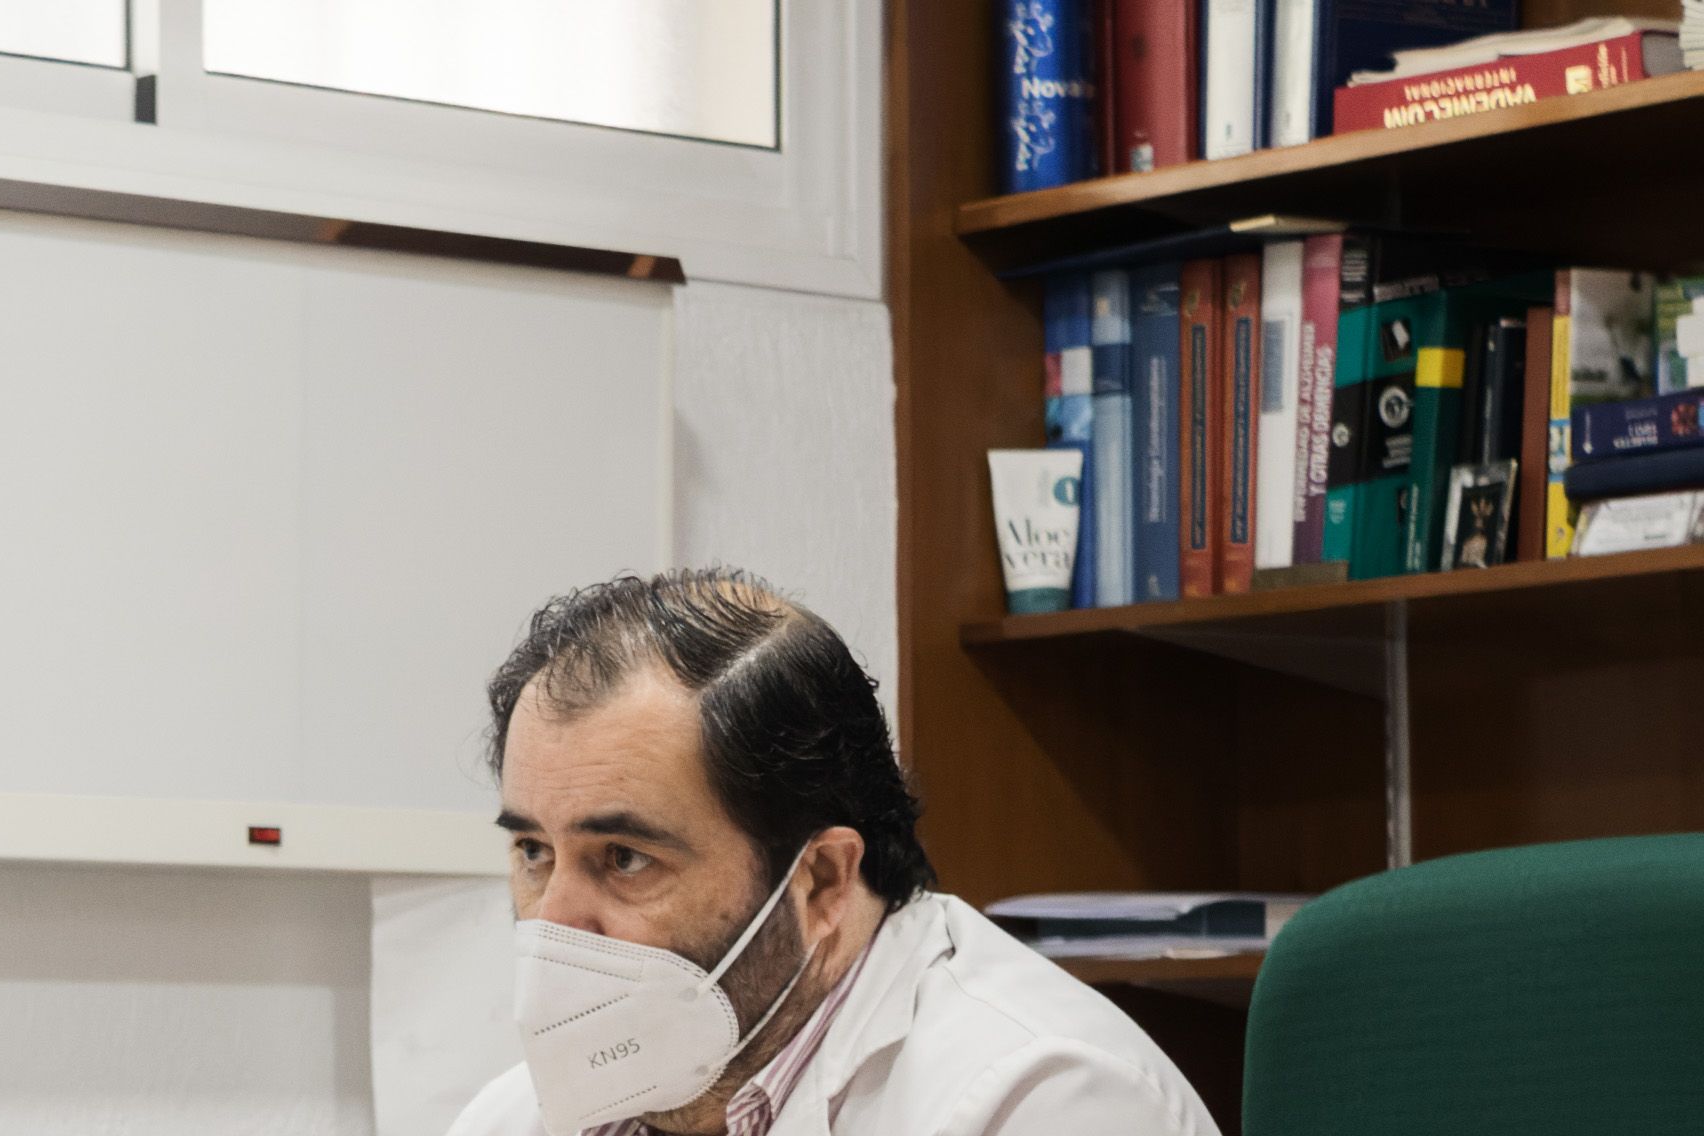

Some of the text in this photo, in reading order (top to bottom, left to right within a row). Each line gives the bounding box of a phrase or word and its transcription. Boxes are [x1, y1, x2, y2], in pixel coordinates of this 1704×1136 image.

[1404, 66, 1517, 101] INTERNACIONAL
[1384, 83, 1536, 129] VADEMECUM
[1309, 432, 1330, 483] OTRAS
[1004, 517, 1071, 546] Aloe
[588, 1038, 640, 1069] KN95
